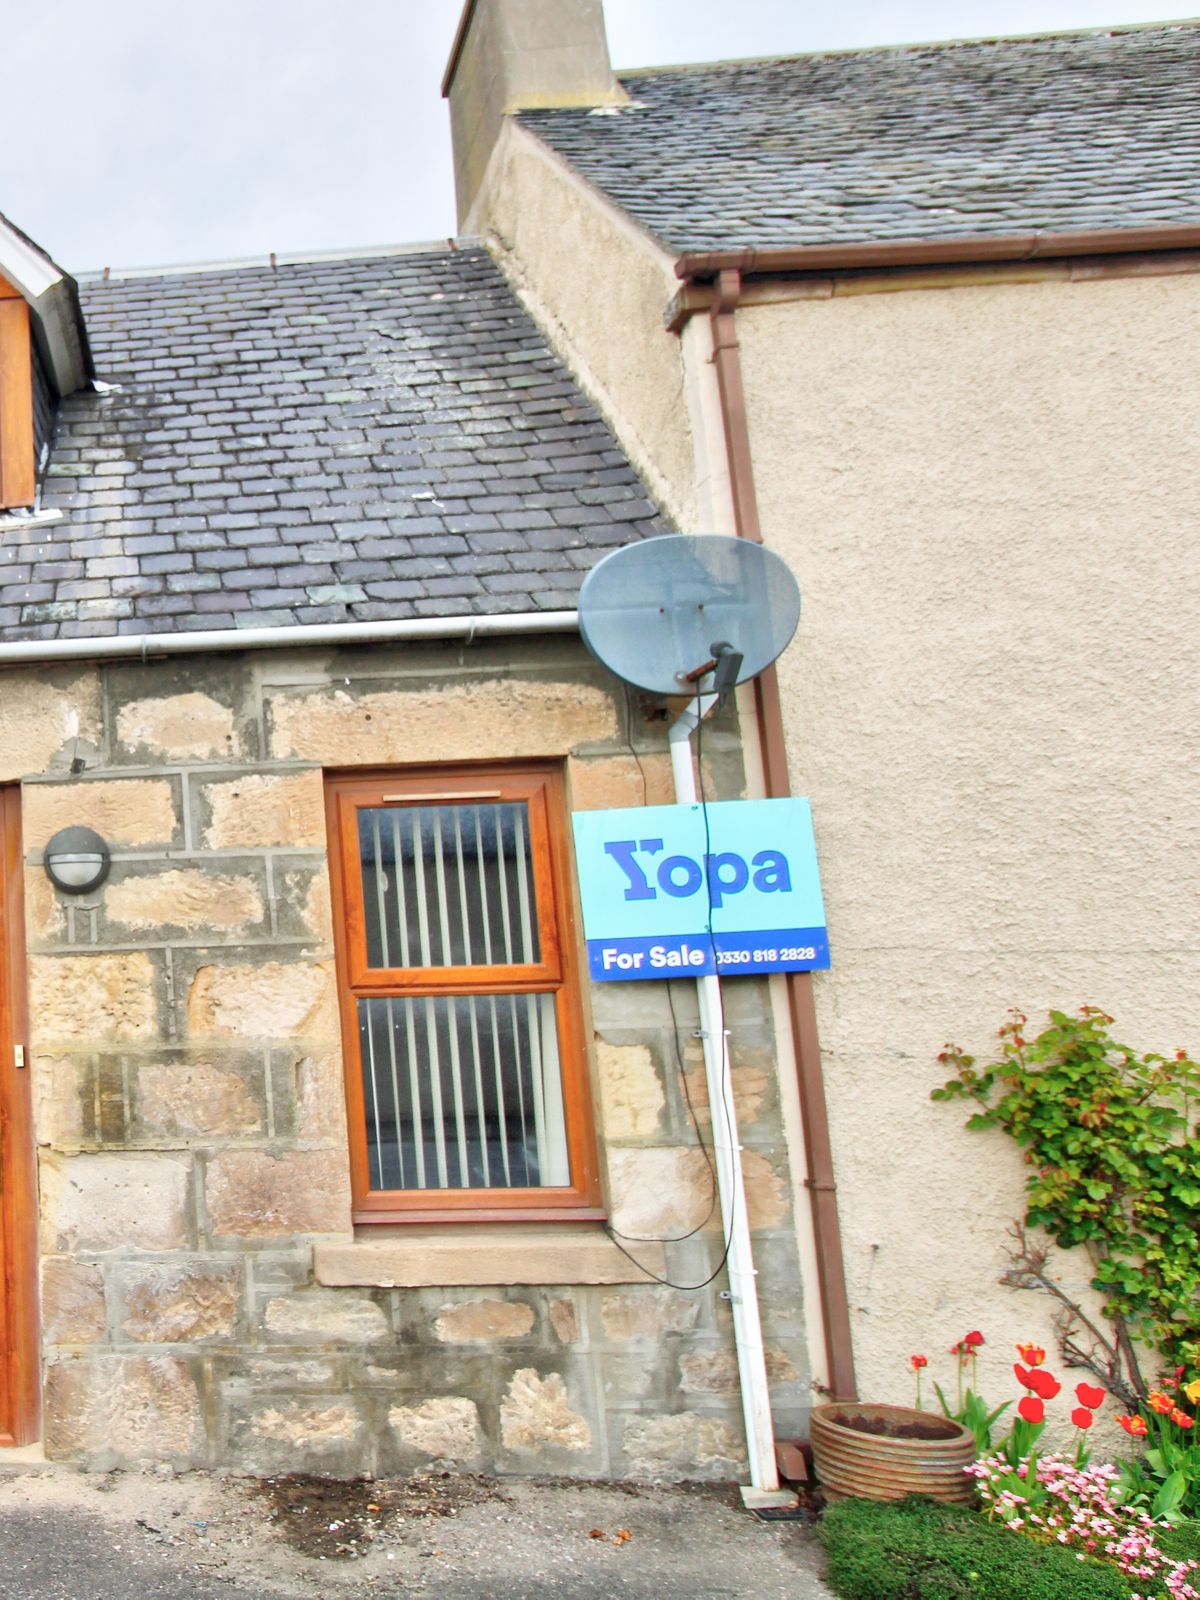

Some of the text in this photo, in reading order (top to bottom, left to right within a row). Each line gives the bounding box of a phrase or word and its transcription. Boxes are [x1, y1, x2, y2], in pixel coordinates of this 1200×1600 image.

[604, 838, 792, 908] Yopa
[602, 944, 704, 970] For Sale
[714, 946, 816, 965] 0330 818 2828
